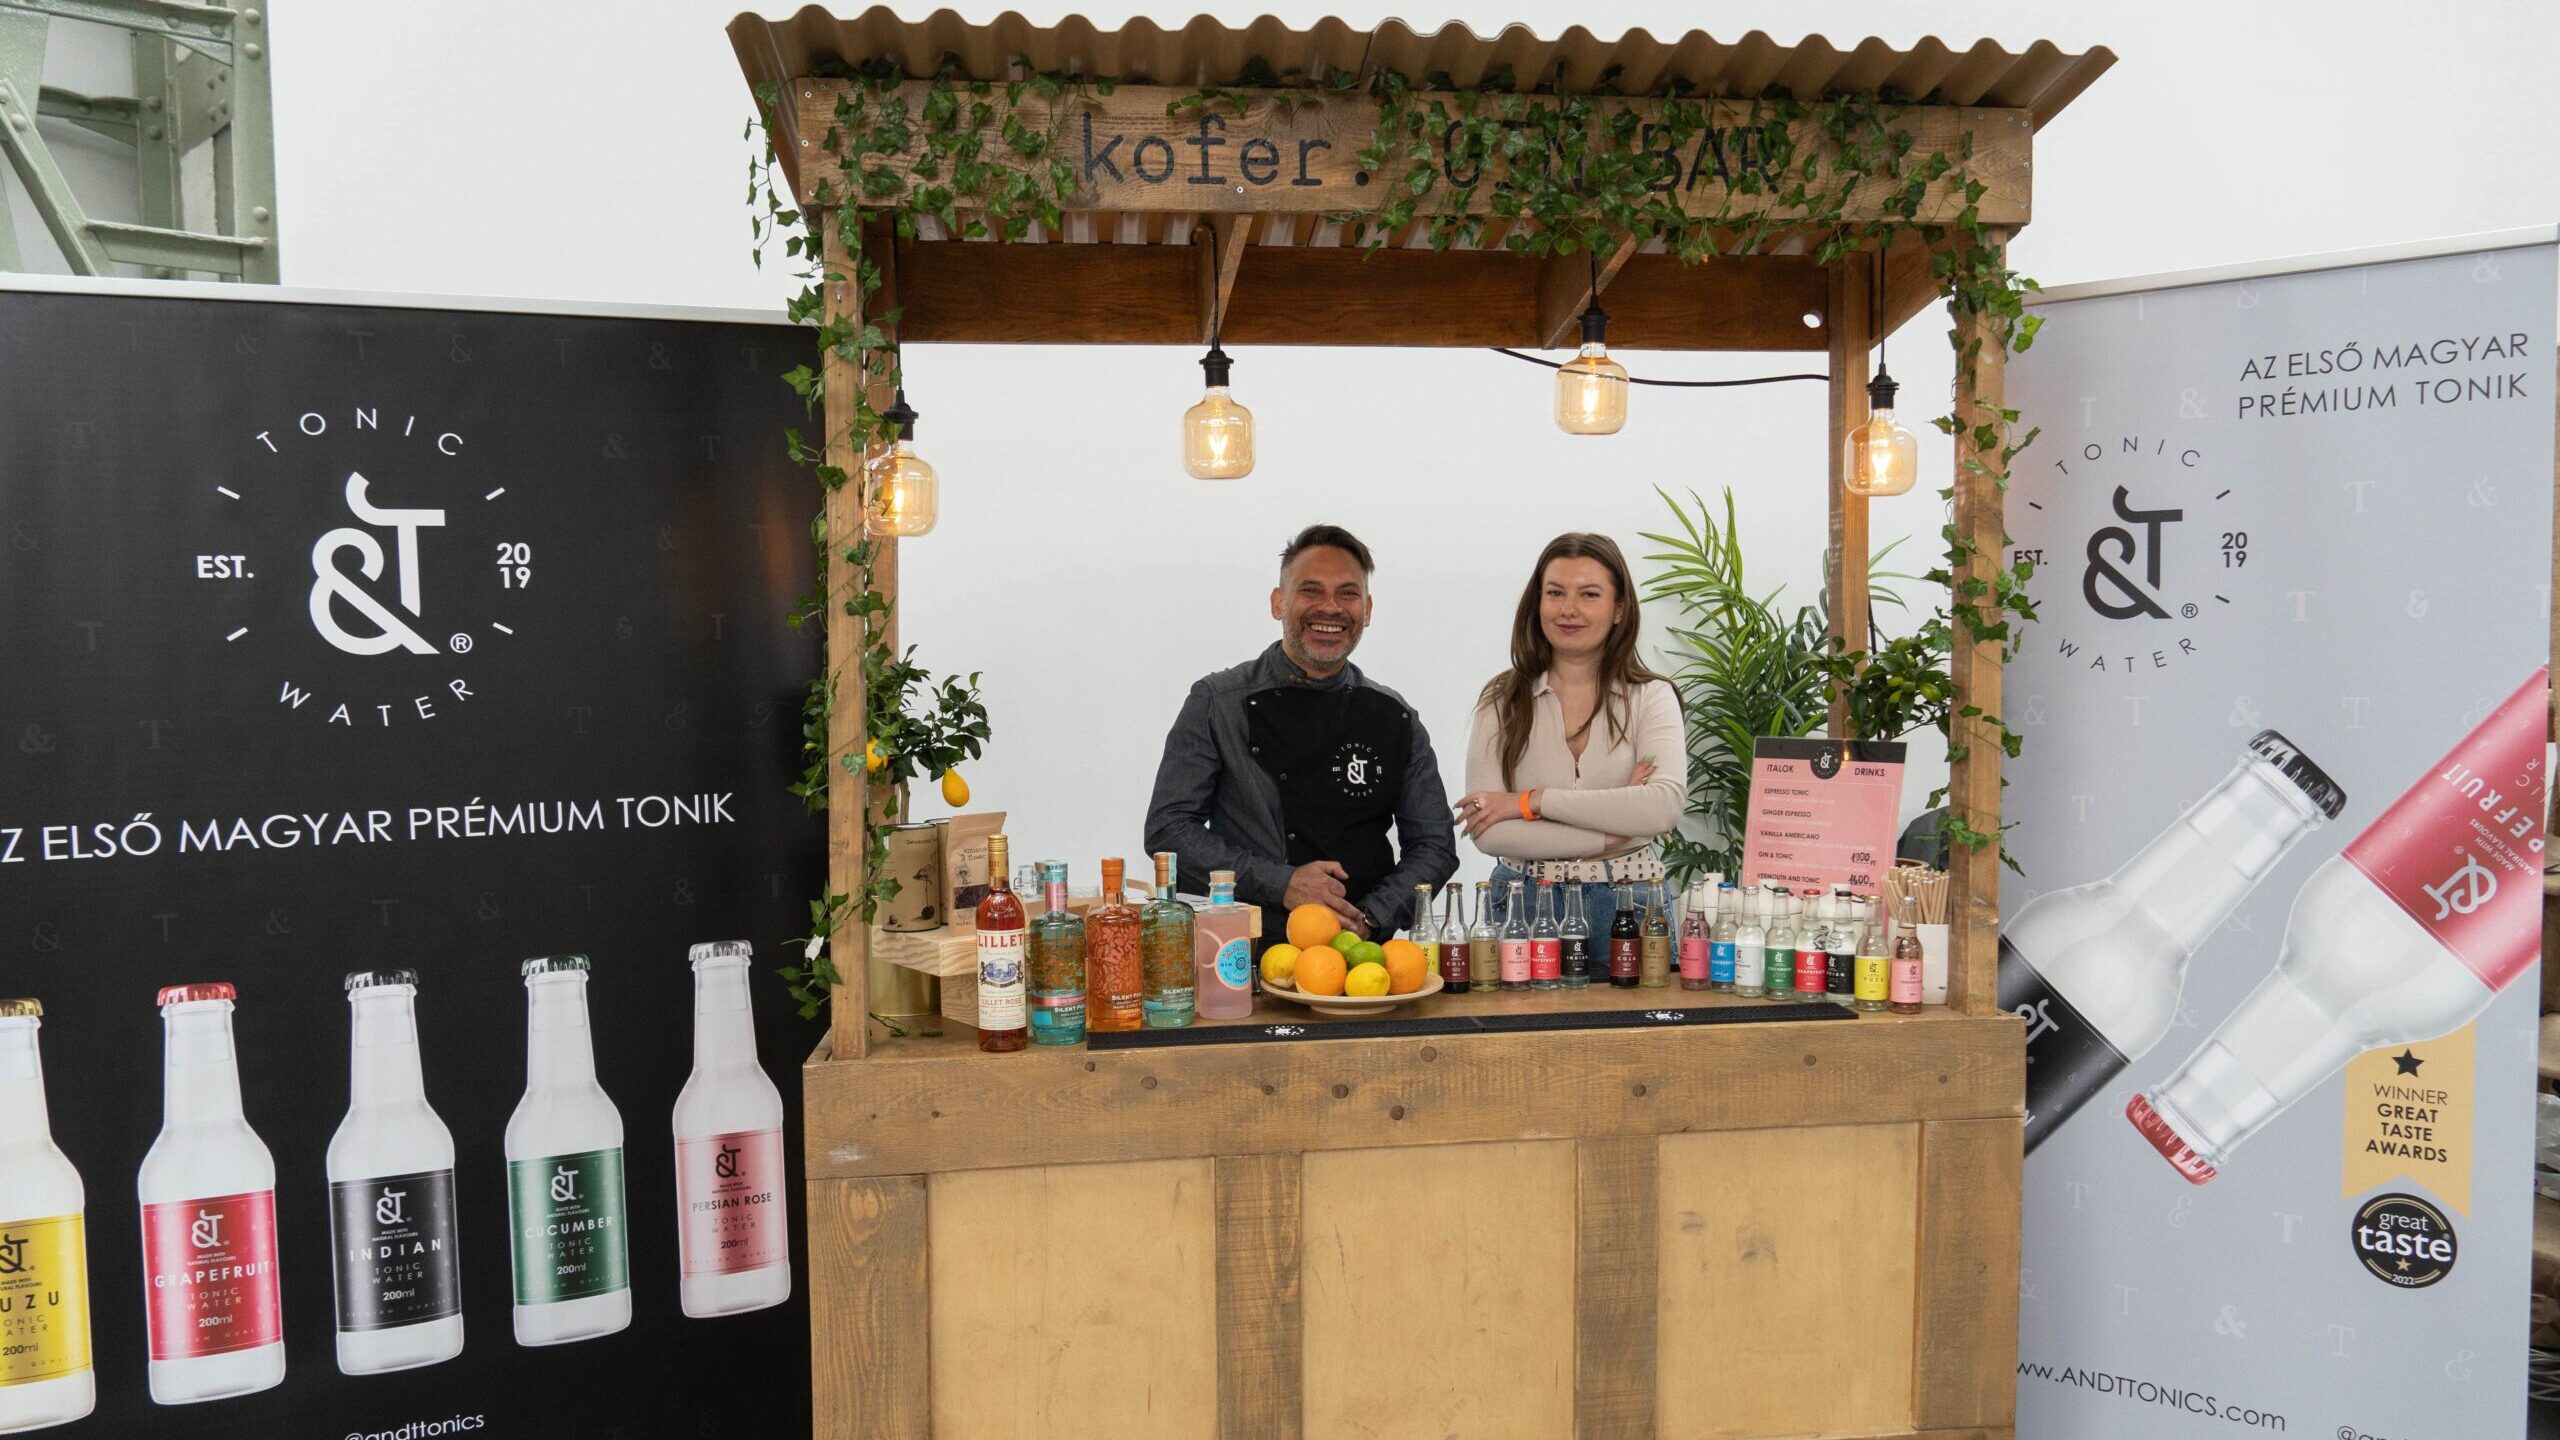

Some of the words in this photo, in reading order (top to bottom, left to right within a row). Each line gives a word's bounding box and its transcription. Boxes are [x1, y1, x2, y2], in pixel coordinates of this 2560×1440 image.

[1081, 112, 1370, 187] kofer.
[2239, 355, 2278, 382] AZ
[2288, 341, 2364, 378] ELSŐ
[2372, 332, 2529, 371] MAGYAR
[2238, 384, 2398, 419] PRÉMIUM
[2415, 372, 2529, 406] TONIK
[256, 407, 463, 455] TONIC
[2056, 436, 2201, 475] TONIC
[197, 555, 255, 579] EST.
[2058, 637, 2198, 673] WATER
[280, 678, 474, 727] WATER
[1854, 768, 1885, 777] DRINKS
[1785, 810, 1811, 818] ESPRESSO
[2441, 763, 2544, 853] PEFRUIT
[1, 828, 24, 863] Z
[43, 813, 162, 861] ELSŐ
[179, 810, 393, 853] MAGYAR
[409, 797, 605, 840] PRÉMIUM
[616, 792, 736, 828] TONIK
[1760, 830, 1783, 838] VANILLA
[1784, 832, 1820, 840] AMERICANO
[2474, 837, 2496, 856] WITH
[1775, 852, 1793, 860] TONIC
[2494, 849, 2516, 871] MADE
[1757, 872, 1787, 881] VERMOUTH
[1788, 874, 1800, 882] AND
[977, 934, 1023, 947] LILLET
[2374, 1084, 2448, 1105] WINNER
[2377, 1103, 2438, 1123] GREAT
[2381, 1122, 2432, 1142] TASTE
[2366, 1139, 2447, 1163] AWARDS
[692, 1197, 740, 1212] PERSIAN
[744, 1192, 772, 1206] ROSE
[524, 1216, 613, 1239] CUCUMBER
[711, 1221, 756, 1234] WATER
[714, 1213, 753, 1225] TONIC
[2379, 1213, 2429, 1231] great
[349, 1238, 442, 1262] INDIAN
[549, 1237, 591, 1250] TONIC
[720, 1238, 748, 1249] 200ml
[2358, 1224, 2451, 1262] taste
[547, 1246, 594, 1259] WATER
[154, 1261, 270, 1288] GRAPEFRUIT
[375, 1262, 421, 1275] TONIC
[556, 1262, 586, 1275] 200ml
[372, 1271, 424, 1285] WATER
[2392, 1274, 2415, 1285] 2022
[0, 1290, 60, 1313] UZU
[191, 1287, 239, 1300] TONIC
[382, 1288, 415, 1301] 200ml
[187, 1296, 242, 1311] WATER
[3, 1314, 46, 1327] ONIC
[199, 1315, 233, 1328] 200ml
[6, 1325, 49, 1337] ATER
[3, 1343, 39, 1356] 200ml
[2017, 1362, 2286, 1431] ww.ANDTTONICS.com
